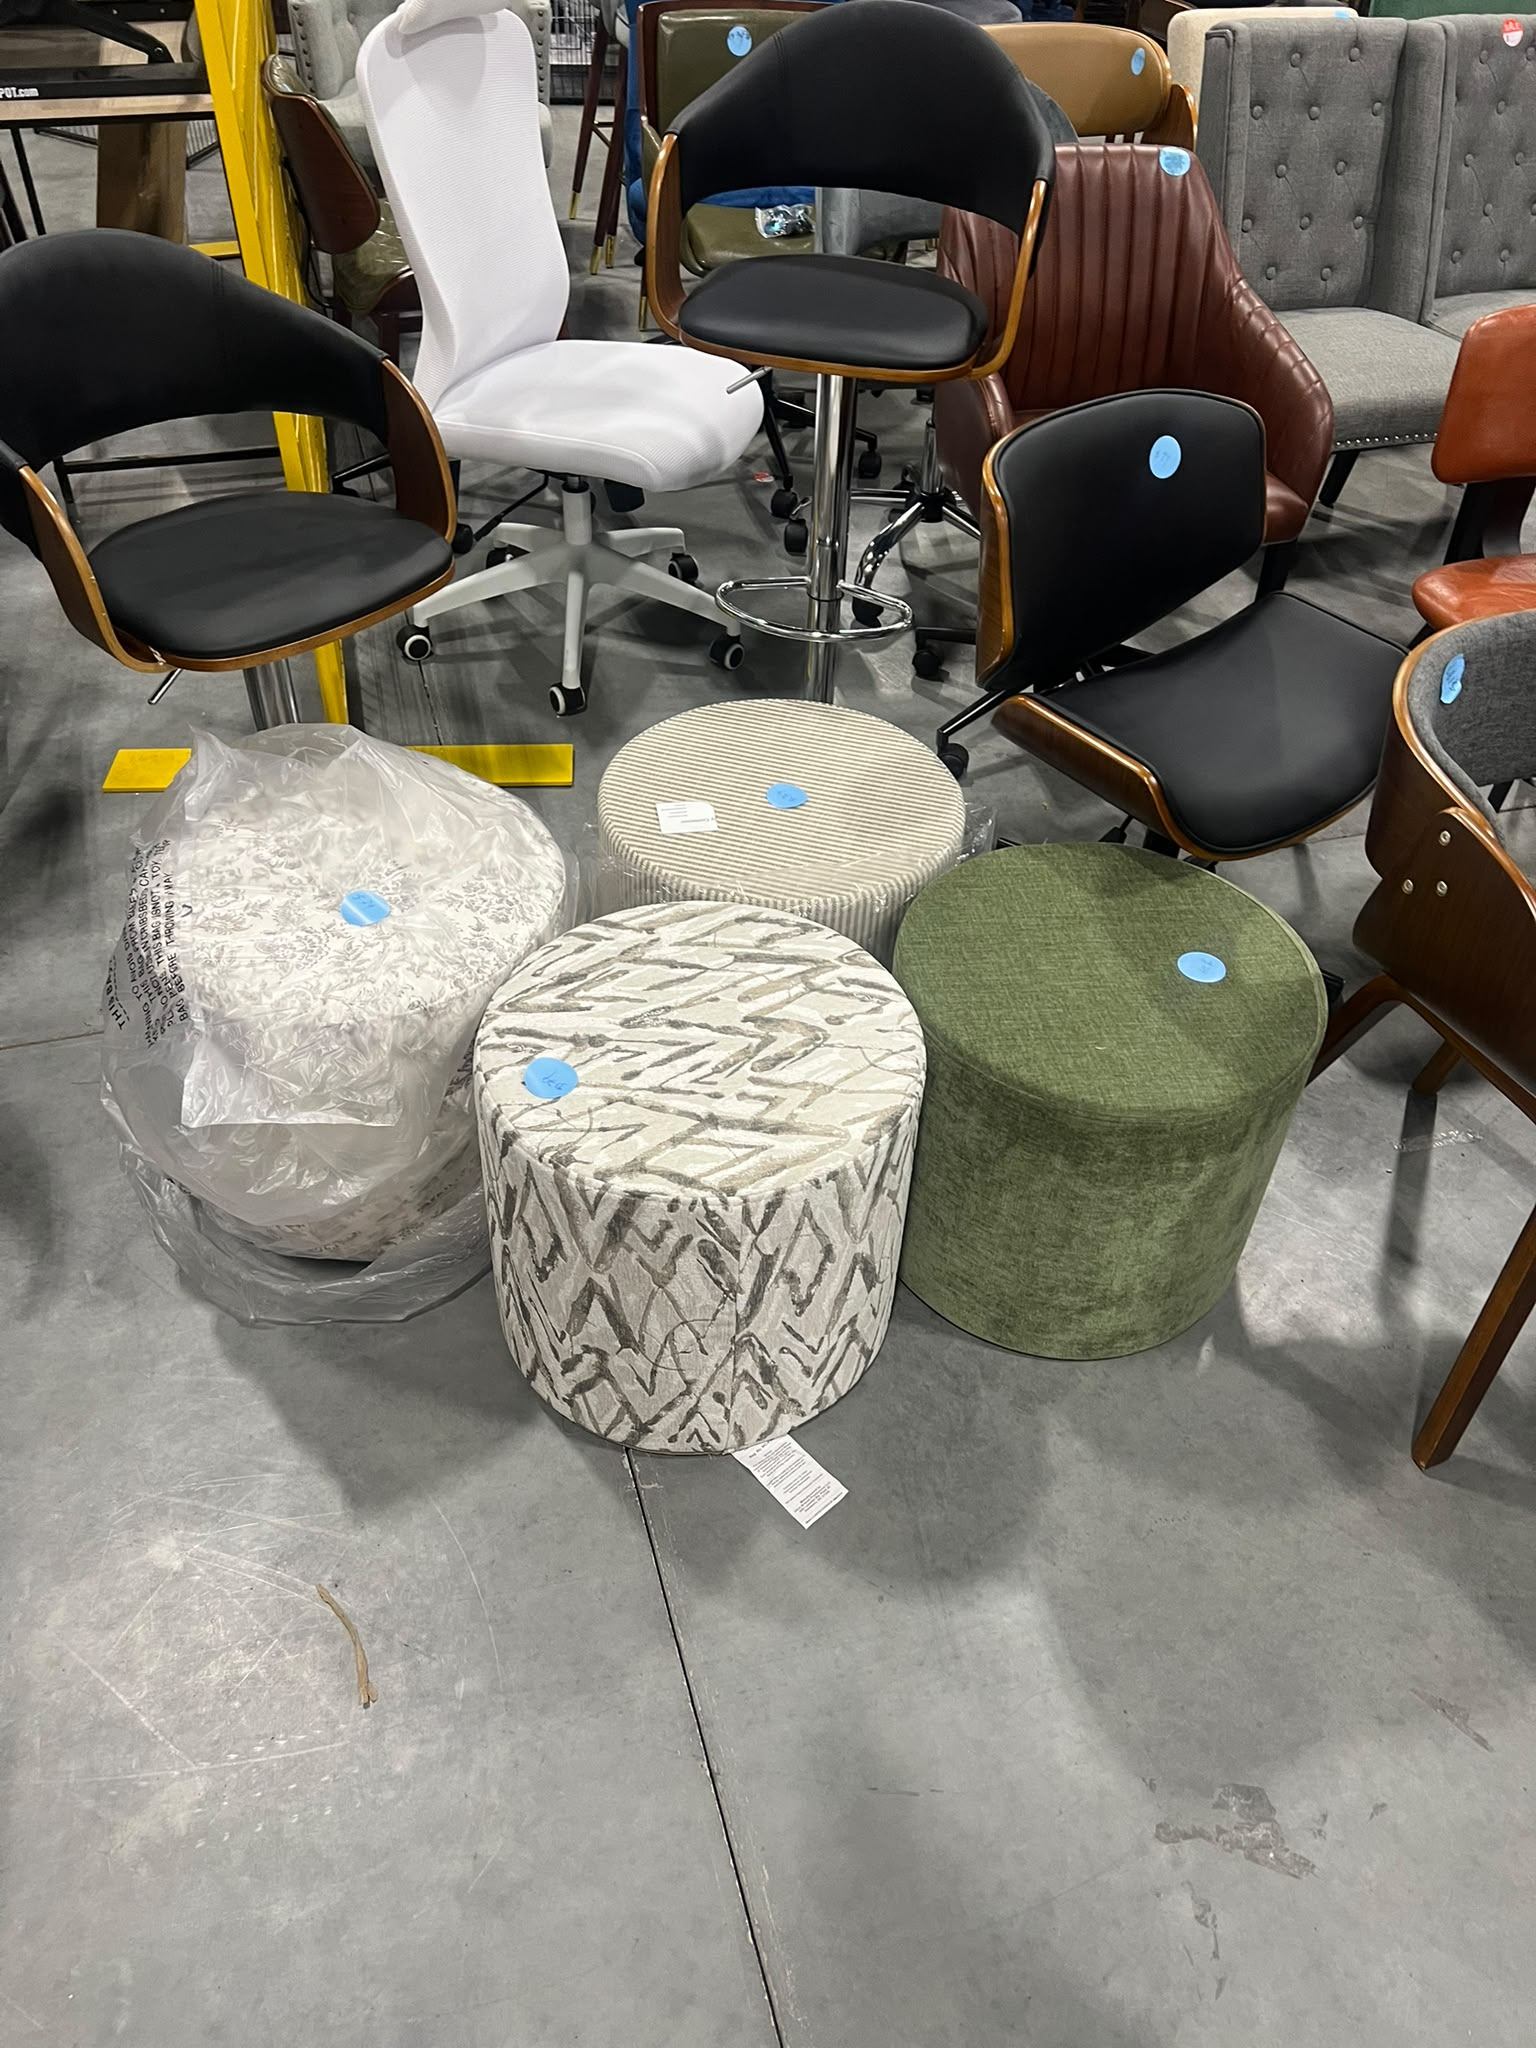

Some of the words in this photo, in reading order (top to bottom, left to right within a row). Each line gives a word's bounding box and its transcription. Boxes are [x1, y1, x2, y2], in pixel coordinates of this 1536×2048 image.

[151, 920, 161, 942] BAG
[164, 900, 175, 947] THROWING
[152, 942, 165, 967] THIS
[166, 952, 186, 994] BEFORE
[131, 985, 143, 1002] TO
[139, 979, 157, 1005] THIS
[176, 997, 189, 1022] BAG
